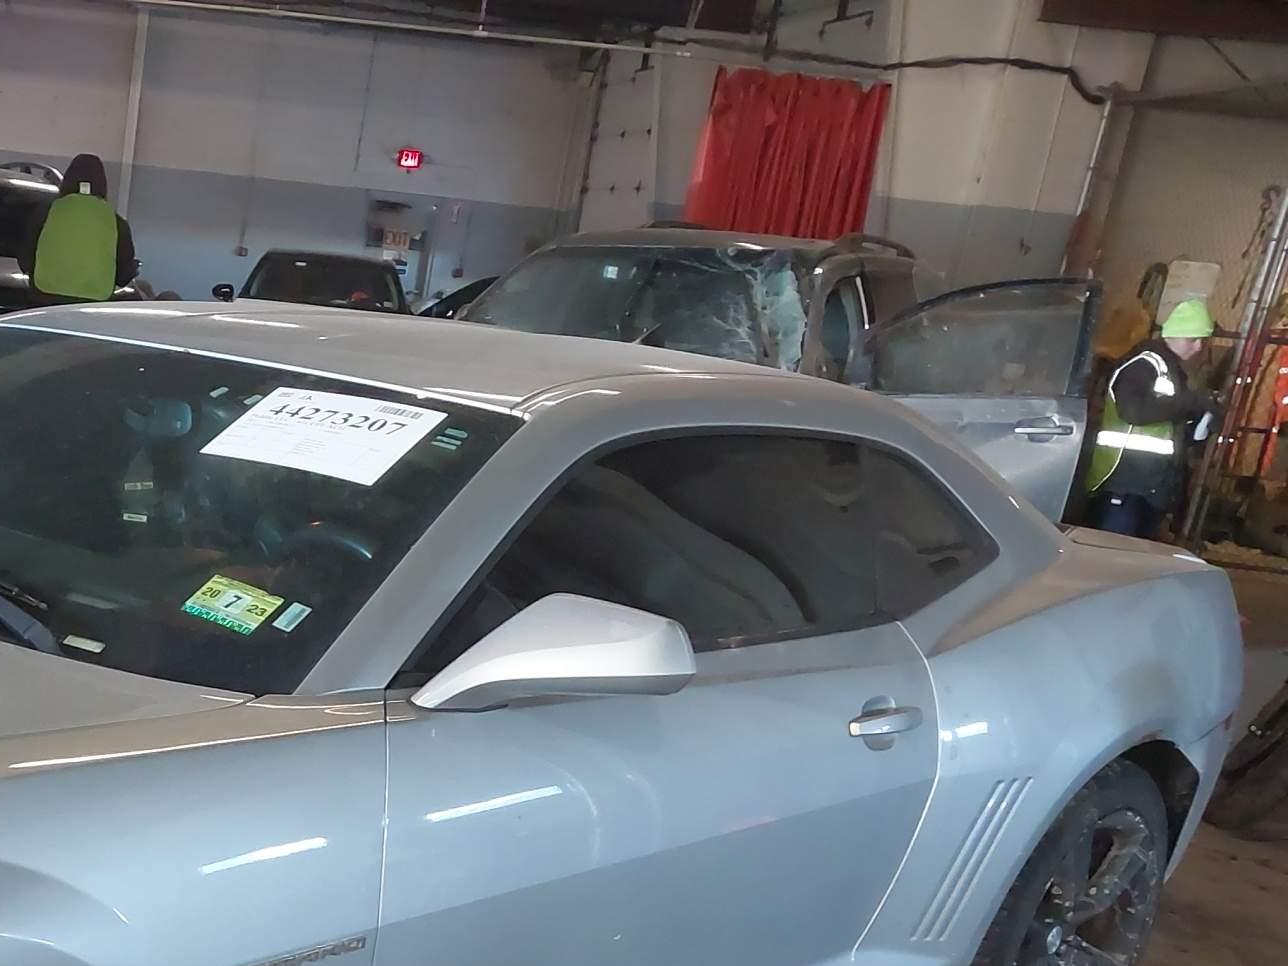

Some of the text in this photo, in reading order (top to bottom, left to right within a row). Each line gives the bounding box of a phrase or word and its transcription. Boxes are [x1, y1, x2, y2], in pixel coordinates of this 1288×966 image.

[400, 151, 420, 167] EXIT
[384, 231, 408, 247] EXIT
[269, 403, 409, 436] 44273207
[200, 586, 267, 617] 20 7 23
